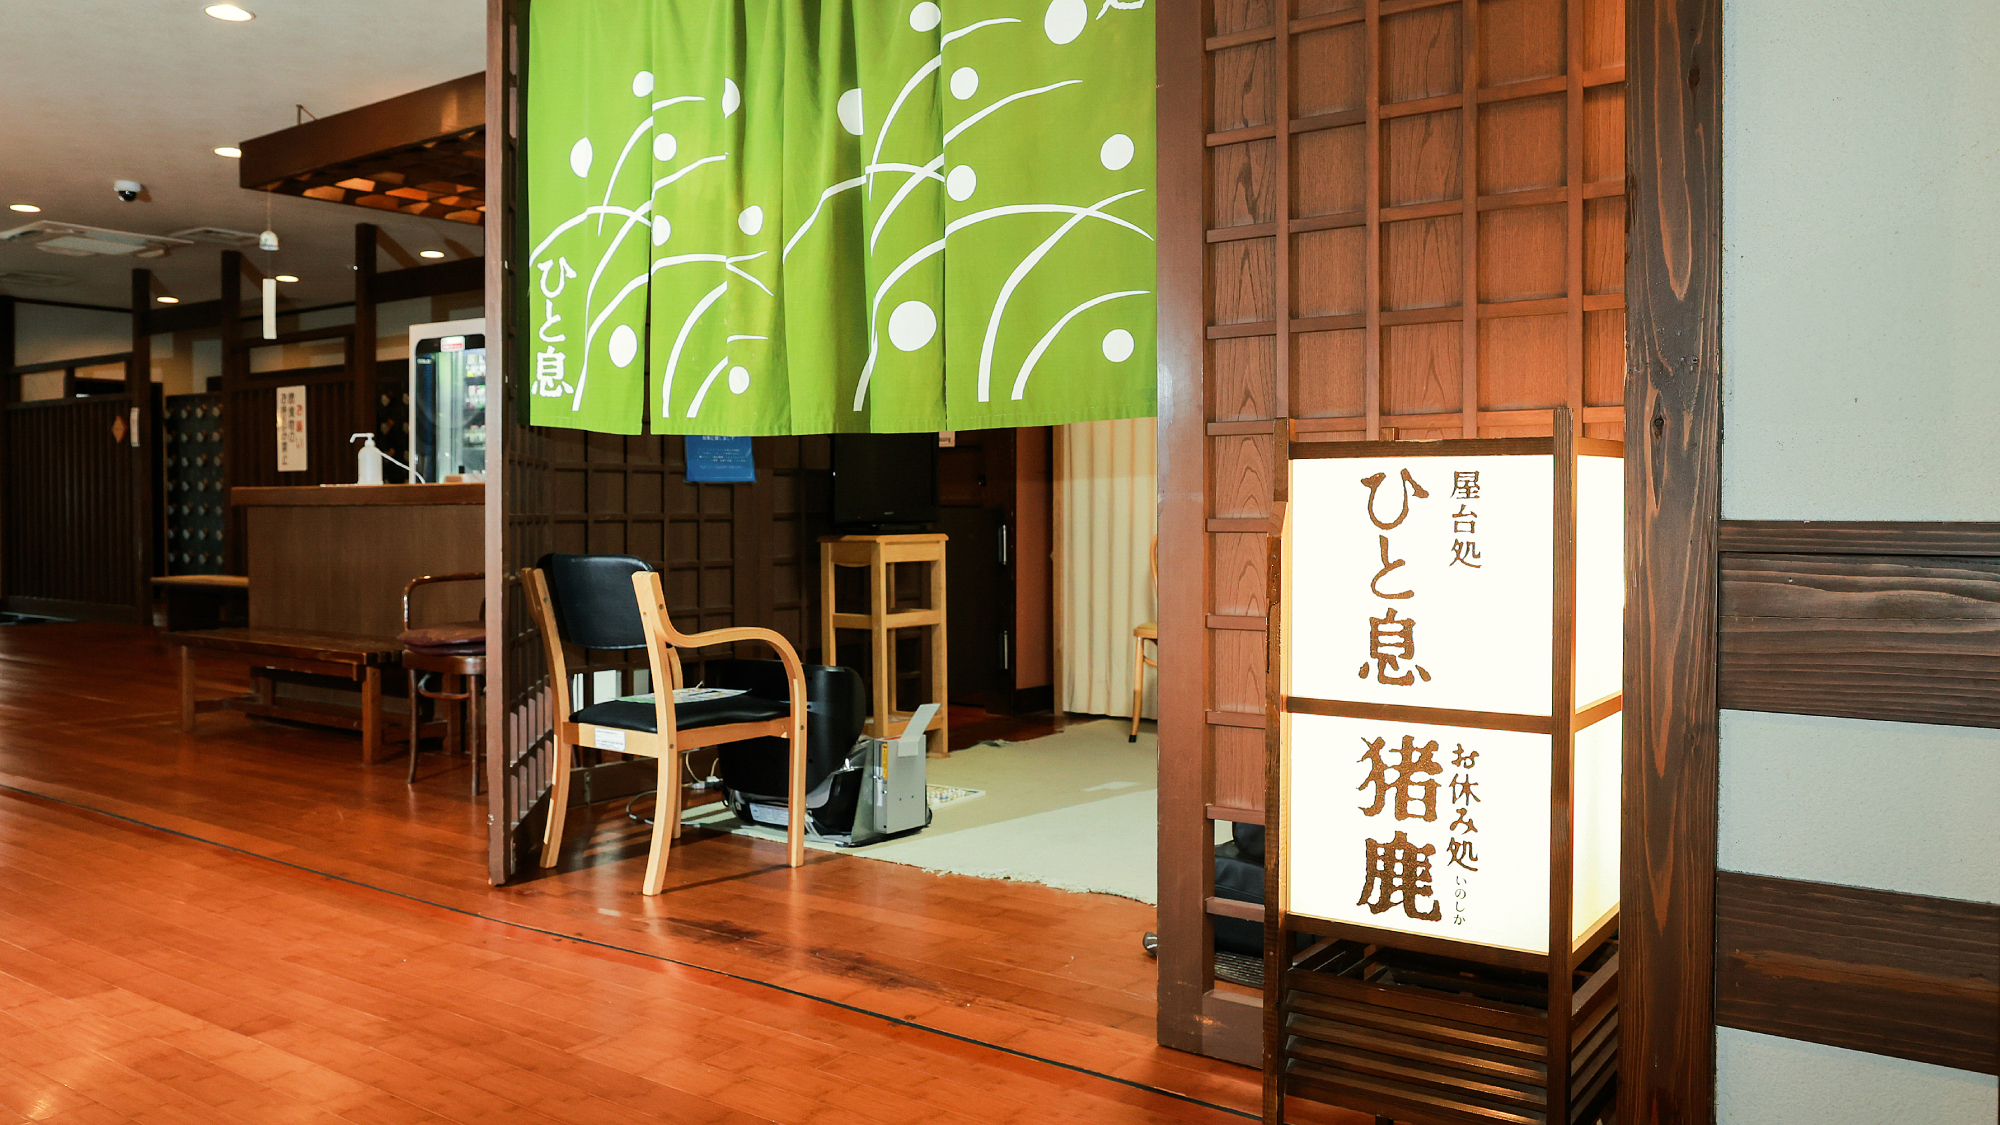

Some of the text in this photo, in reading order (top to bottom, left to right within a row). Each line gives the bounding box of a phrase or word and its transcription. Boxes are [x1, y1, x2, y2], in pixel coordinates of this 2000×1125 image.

[530, 256, 578, 398] ひと息
[1358, 467, 1432, 687] ひと息
[1449, 470, 1482, 569] 屋台処
[1355, 734, 1443, 922] 猪鹿
[1446, 743, 1481, 872] お休み処
[1453, 875, 1468, 926] いのしか
